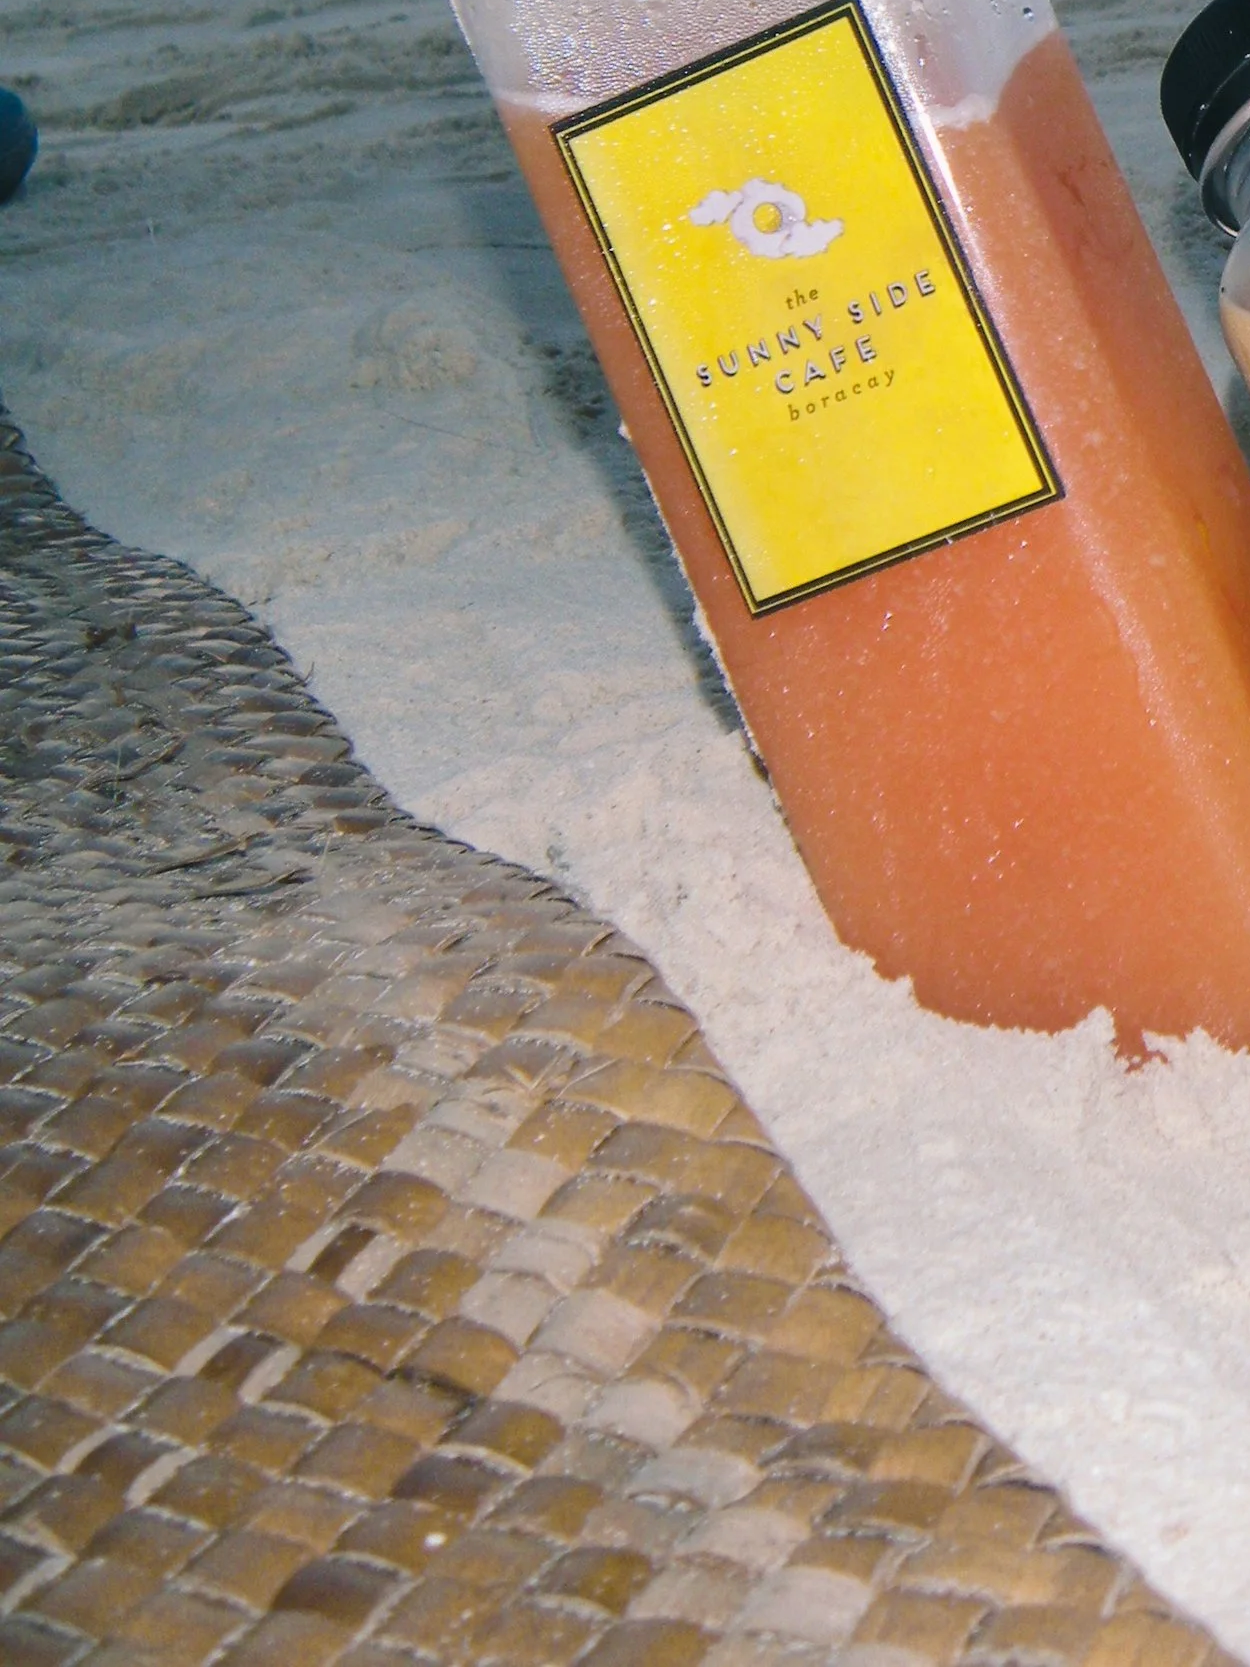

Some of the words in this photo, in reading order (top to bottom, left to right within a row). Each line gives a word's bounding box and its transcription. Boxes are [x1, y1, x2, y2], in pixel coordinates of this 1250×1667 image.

[786, 288, 819, 310] the
[696, 314, 823, 387] SUNNY
[847, 269, 935, 324] SIDE
[774, 334, 877, 394] CAFE
[787, 368, 895, 421] boracay
